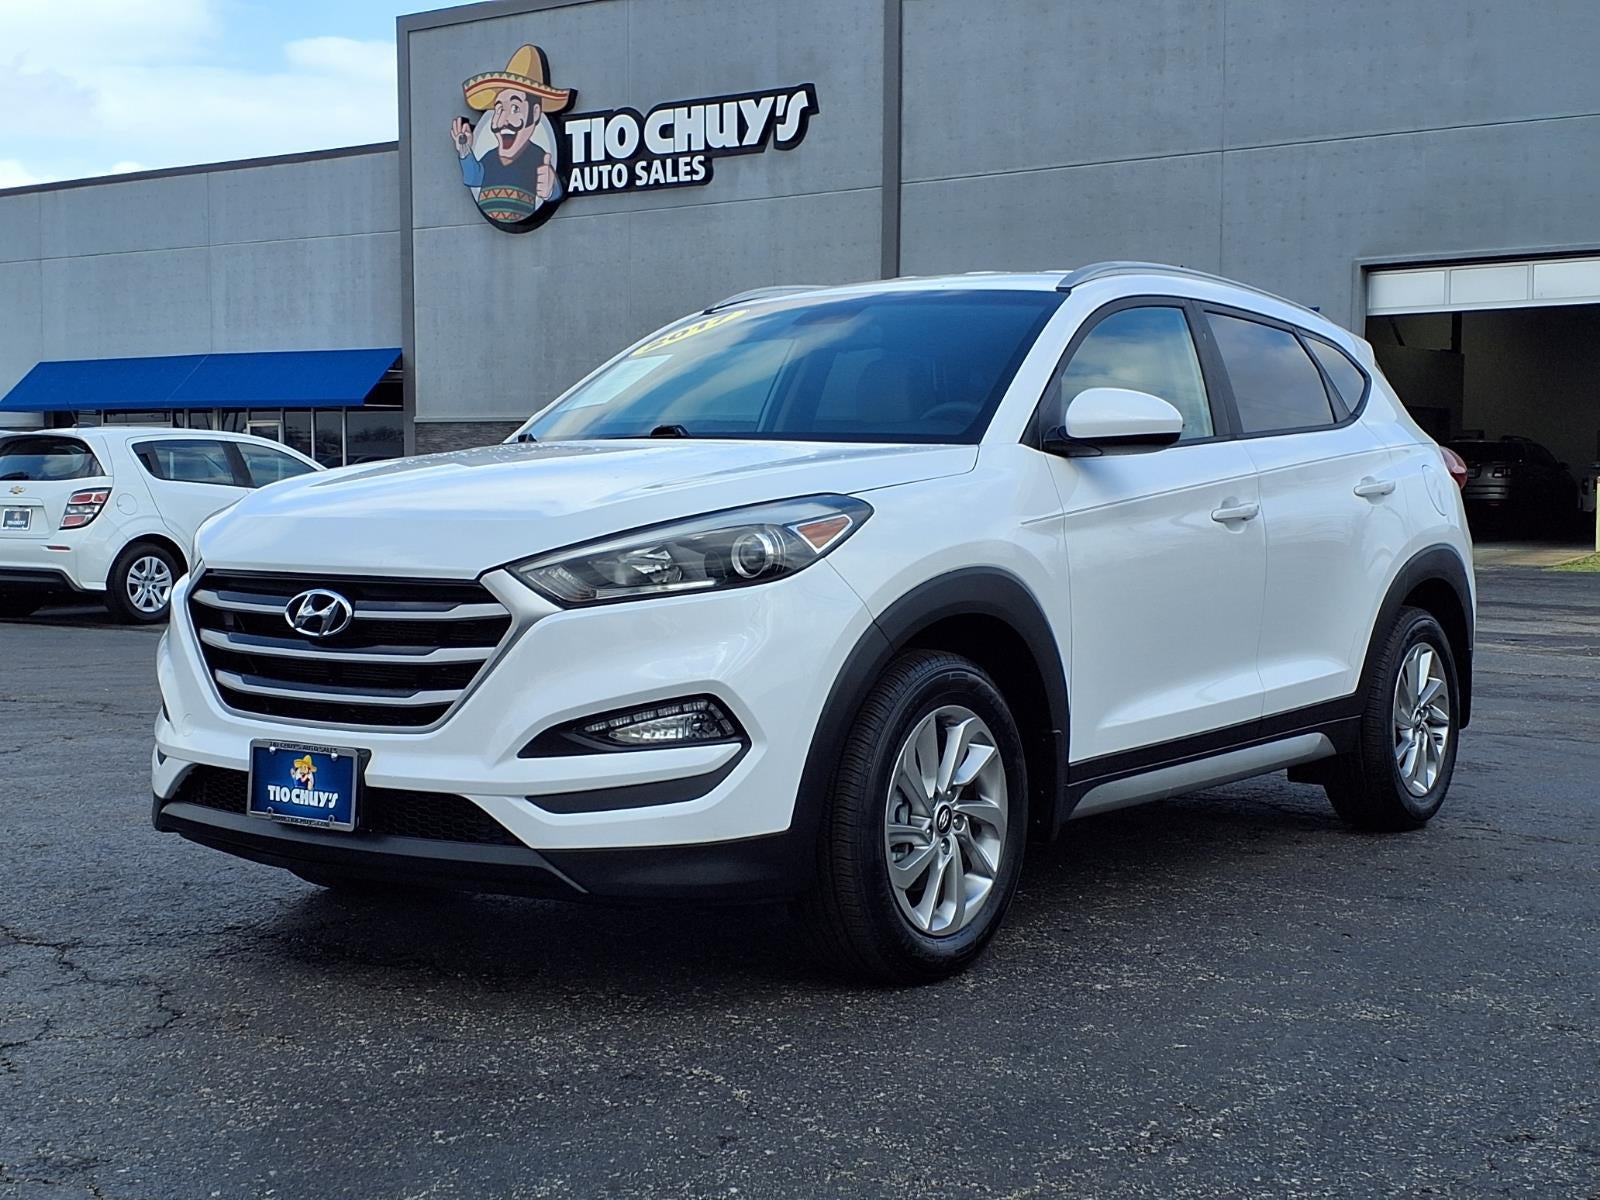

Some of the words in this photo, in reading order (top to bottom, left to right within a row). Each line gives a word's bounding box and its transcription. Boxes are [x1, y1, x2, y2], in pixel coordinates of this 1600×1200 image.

[565, 114, 640, 163] TIO
[644, 90, 808, 154] CHUY'S
[568, 163, 628, 192] AUTO
[635, 155, 706, 186] SALES
[267, 784, 290, 803] TIO
[291, 788, 339, 809] CHUY'S
